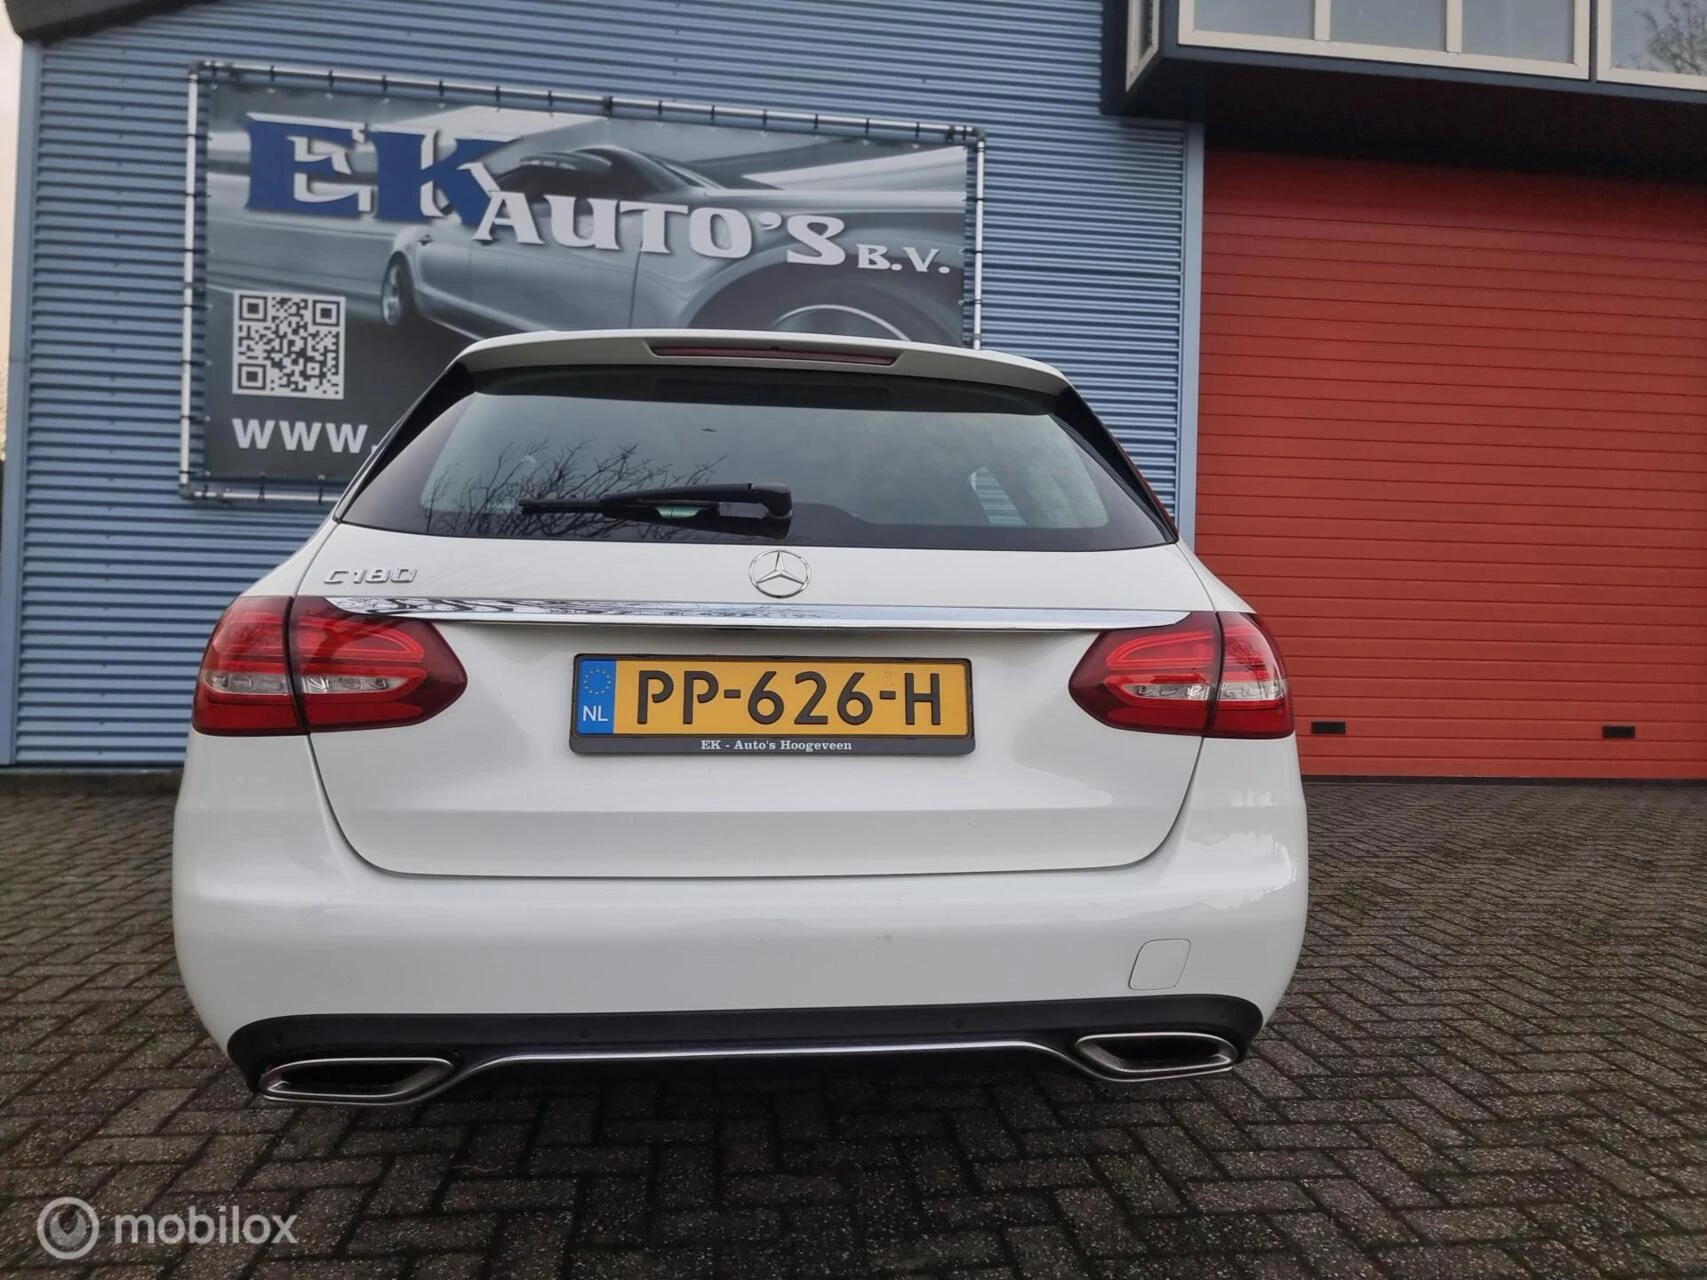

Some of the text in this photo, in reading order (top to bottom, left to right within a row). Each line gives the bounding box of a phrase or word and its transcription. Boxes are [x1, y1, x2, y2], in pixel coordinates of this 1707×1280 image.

[246, 113, 516, 229] EK
[856, 243, 951, 274] B.V.
[582, 705, 608, 722] NL
[637, 670, 941, 726] PP-626-H
[701, 740, 721, 750] EK
[734, 740, 776, 750] Auto's
[780, 740, 852, 752] Hoogeveen
